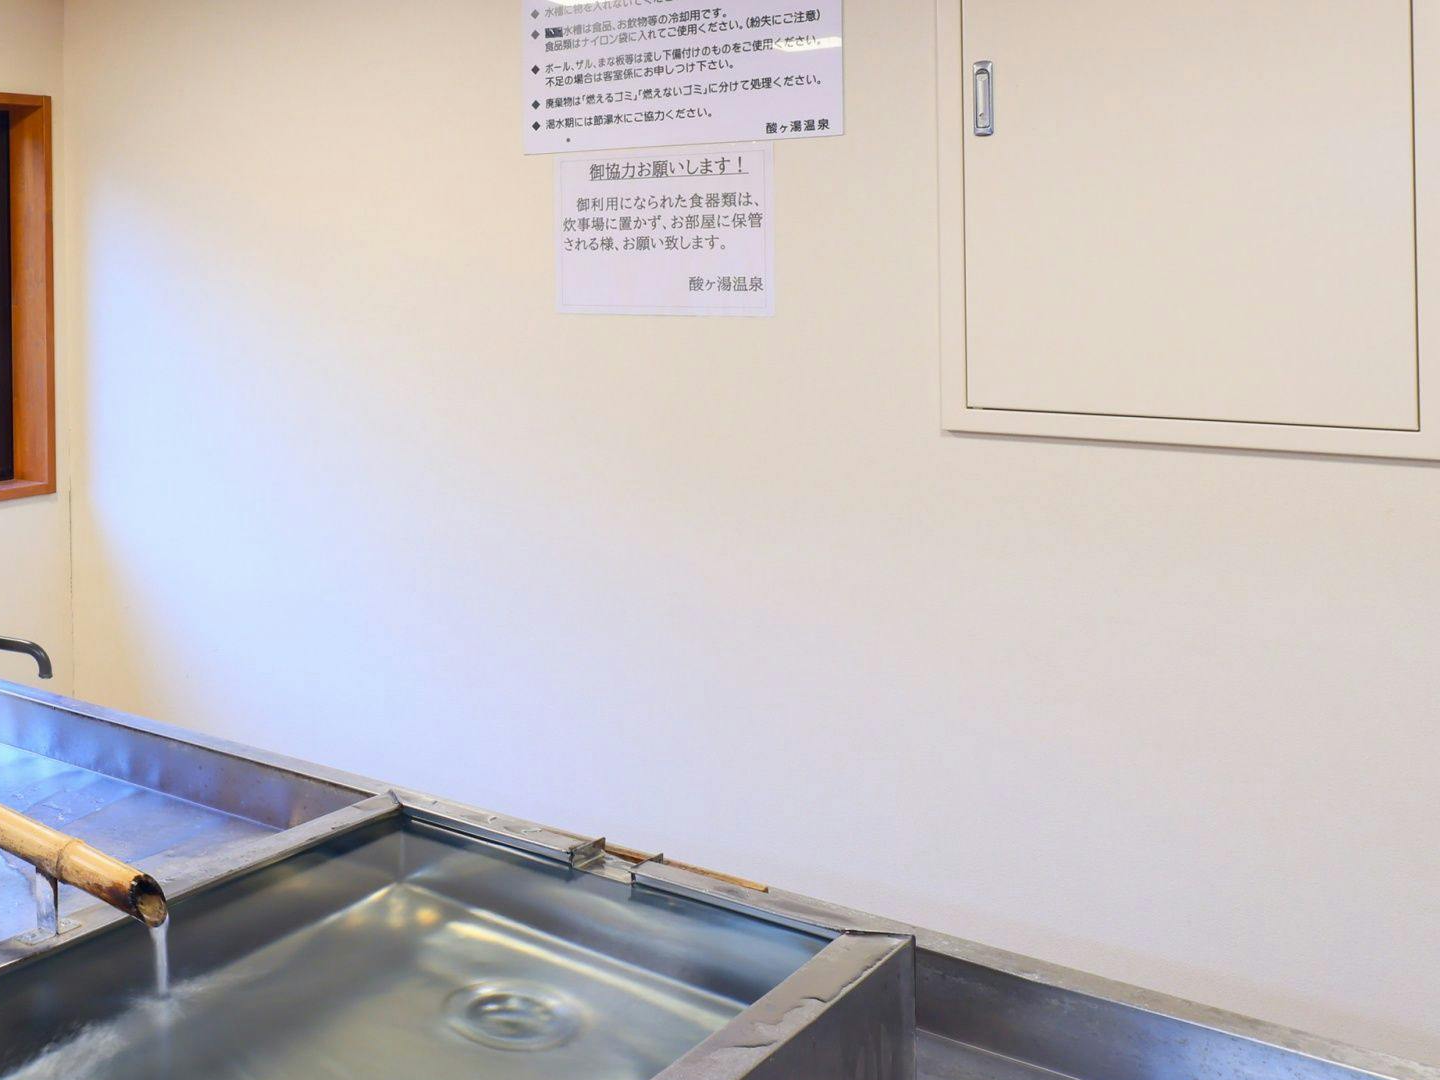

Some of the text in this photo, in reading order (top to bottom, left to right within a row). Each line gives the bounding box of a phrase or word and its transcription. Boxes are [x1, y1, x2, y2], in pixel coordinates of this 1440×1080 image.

[589, 156, 743, 181] 御協力お願いします！
[576, 192, 761, 212] 御利用になられた食器類は、
[563, 213, 764, 232] 炊事場に置かず、お部屋に保管
[564, 235, 727, 252] される様、お願い致します。
